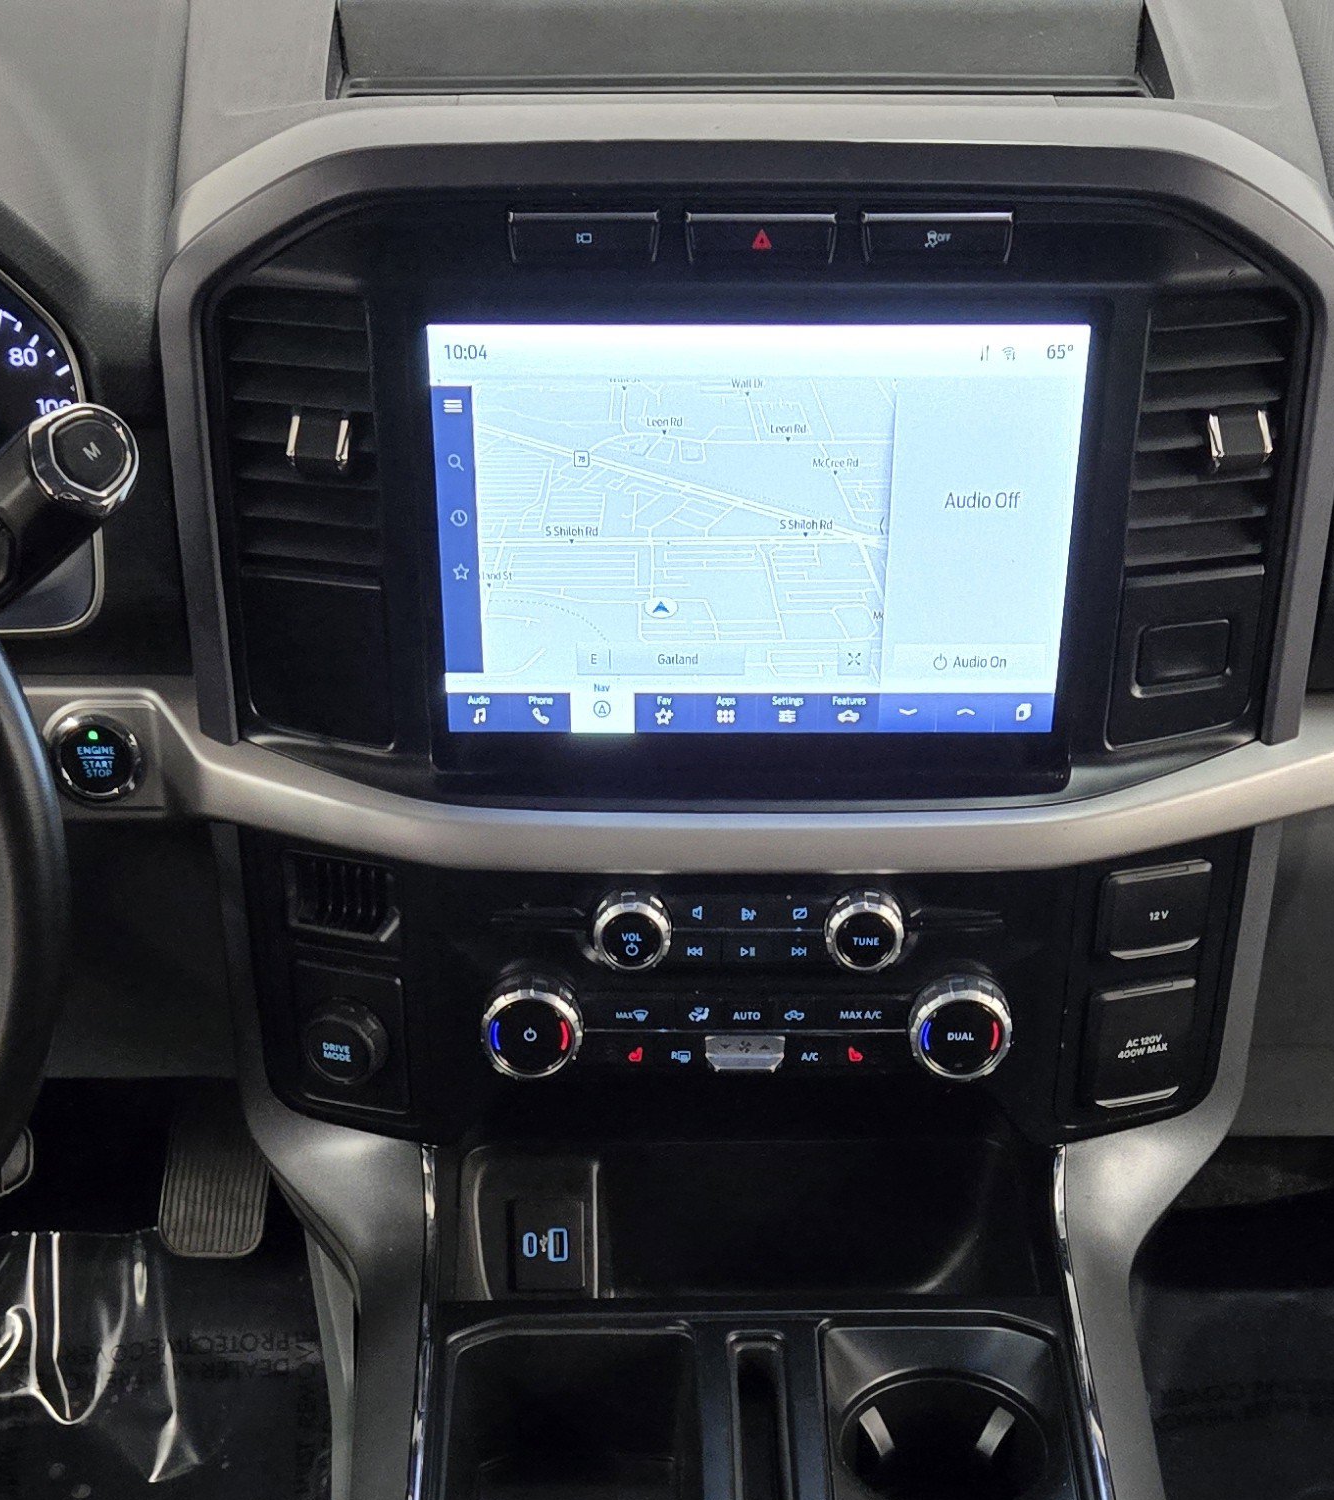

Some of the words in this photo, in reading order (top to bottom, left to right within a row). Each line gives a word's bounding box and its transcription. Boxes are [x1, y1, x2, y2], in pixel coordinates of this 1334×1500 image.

[8, 347, 38, 367] 80
[443, 344, 488, 360] 10:04
[1046, 344, 1074, 360] 65°
[670, 416, 683, 427] Rd
[793, 424, 806, 434] Rd
[82, 442, 102, 461] M
[846, 458, 859, 468] Rd
[944, 491, 991, 509] Audio
[995, 491, 1021, 509] Off
[779, 519, 787, 530] S
[788, 519, 818, 530] Shiloh
[819, 519, 833, 530] Rd
[545, 526, 552, 536] S
[553, 526, 584, 537] Shiloh
[585, 526, 599, 537] Rd
[590, 654, 598, 664] E
[657, 653, 698, 665] Garland
[952, 655, 987, 668] Audio
[990, 656, 1007, 668] On
[593, 683, 610, 693] Nav
[467, 695, 490, 705] Audio
[528, 695, 553, 705] Phone
[656, 695, 672, 705] Fav
[716, 695, 736, 707] Apps
[772, 695, 804, 707] Settings
[832, 695, 867, 706] Features
[76, 745, 116, 755] ENGINE
[82, 760, 113, 769] START
[86, 769, 113, 778] STOP
[1149, 911, 1160, 921] 12
[1161, 910, 1170, 920] V
[621, 932, 643, 942] VOL
[852, 936, 880, 946] TUNE
[732, 1011, 761, 1020] AUTO
[839, 1011, 863, 1019] MAX
[864, 1010, 883, 1020] A/C
[947, 1032, 975, 1041] DUAL
[1126, 1038, 1140, 1049] AC
[1140, 1034, 1163, 1046] 120V
[322, 1041, 351, 1054] DRIVE
[1117, 1046, 1146, 1060] 400W
[1146, 1042, 1168, 1055] MAX
[323, 1051, 352, 1062] MODE
[800, 1051, 819, 1061] A/C
